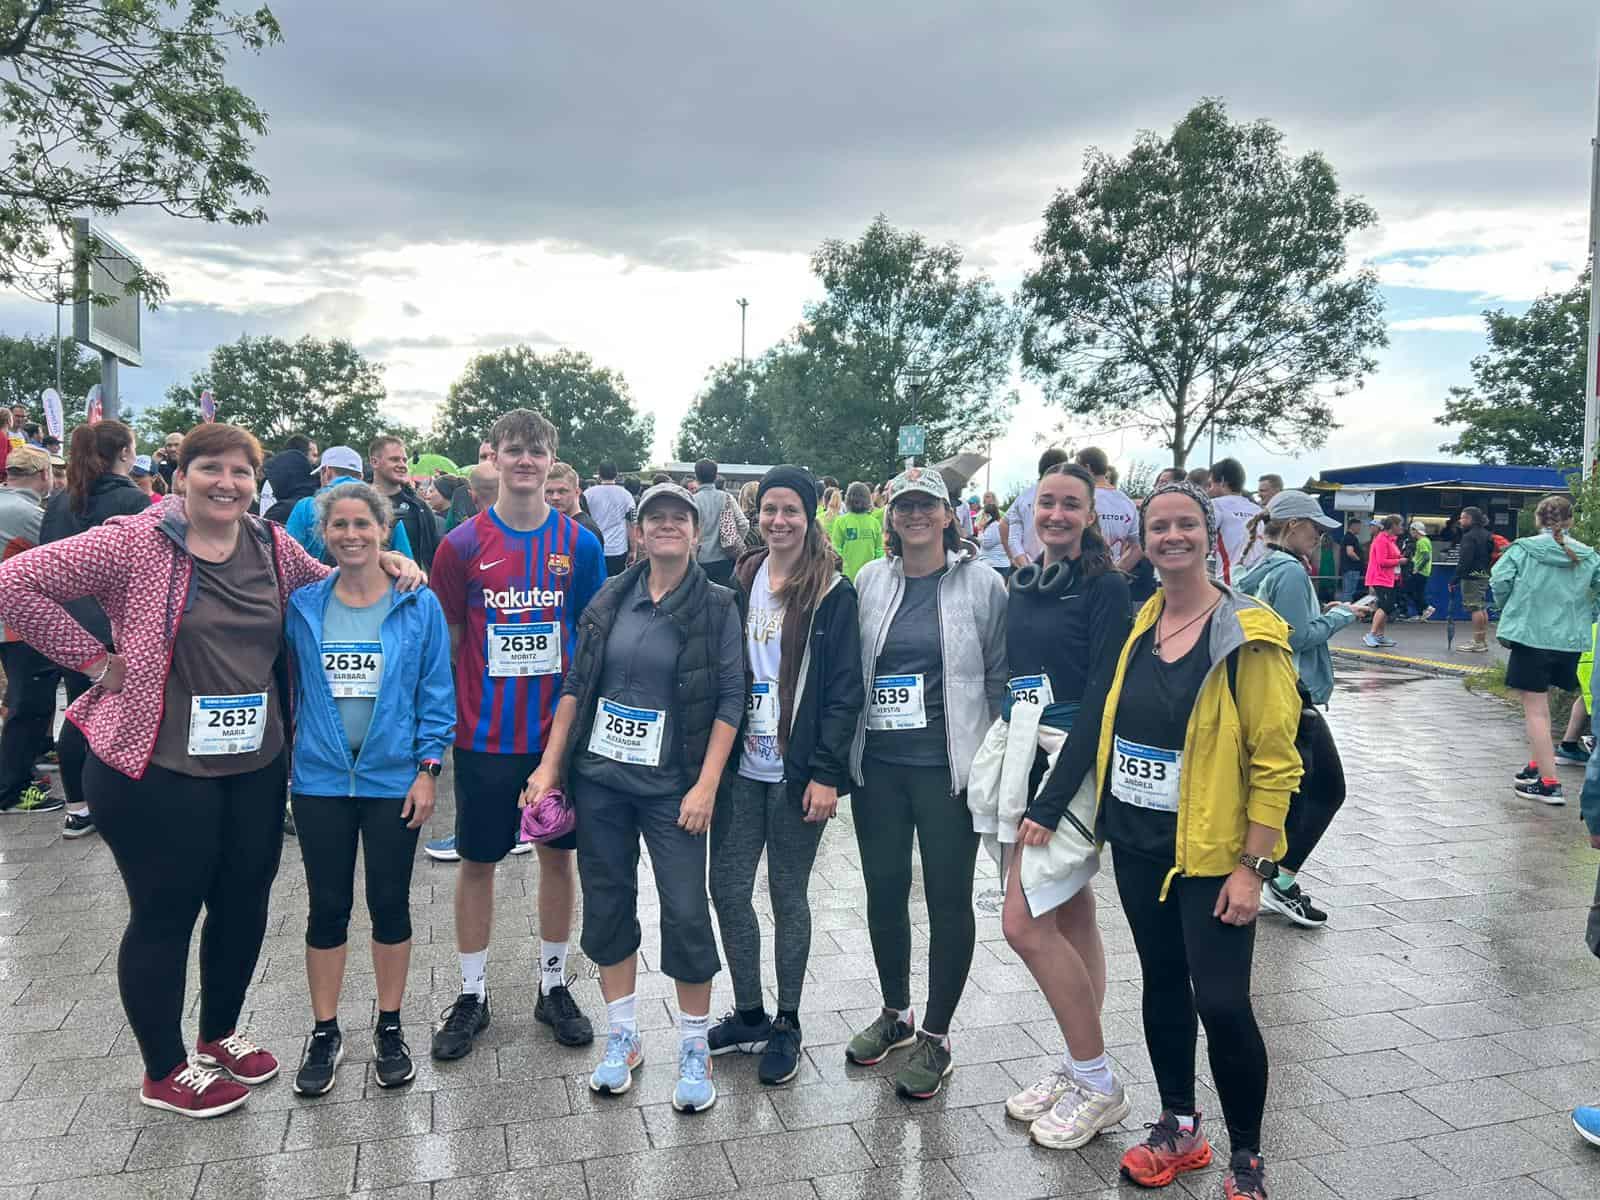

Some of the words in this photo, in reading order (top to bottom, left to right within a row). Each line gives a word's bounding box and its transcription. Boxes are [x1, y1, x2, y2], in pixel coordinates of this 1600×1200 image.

[483, 586, 564, 609] Rakuten
[501, 635, 548, 652] 2638
[325, 654, 377, 671] 2634
[208, 708, 257, 727] 2632
[606, 714, 649, 738] 2635
[1119, 754, 1166, 781] 2633
